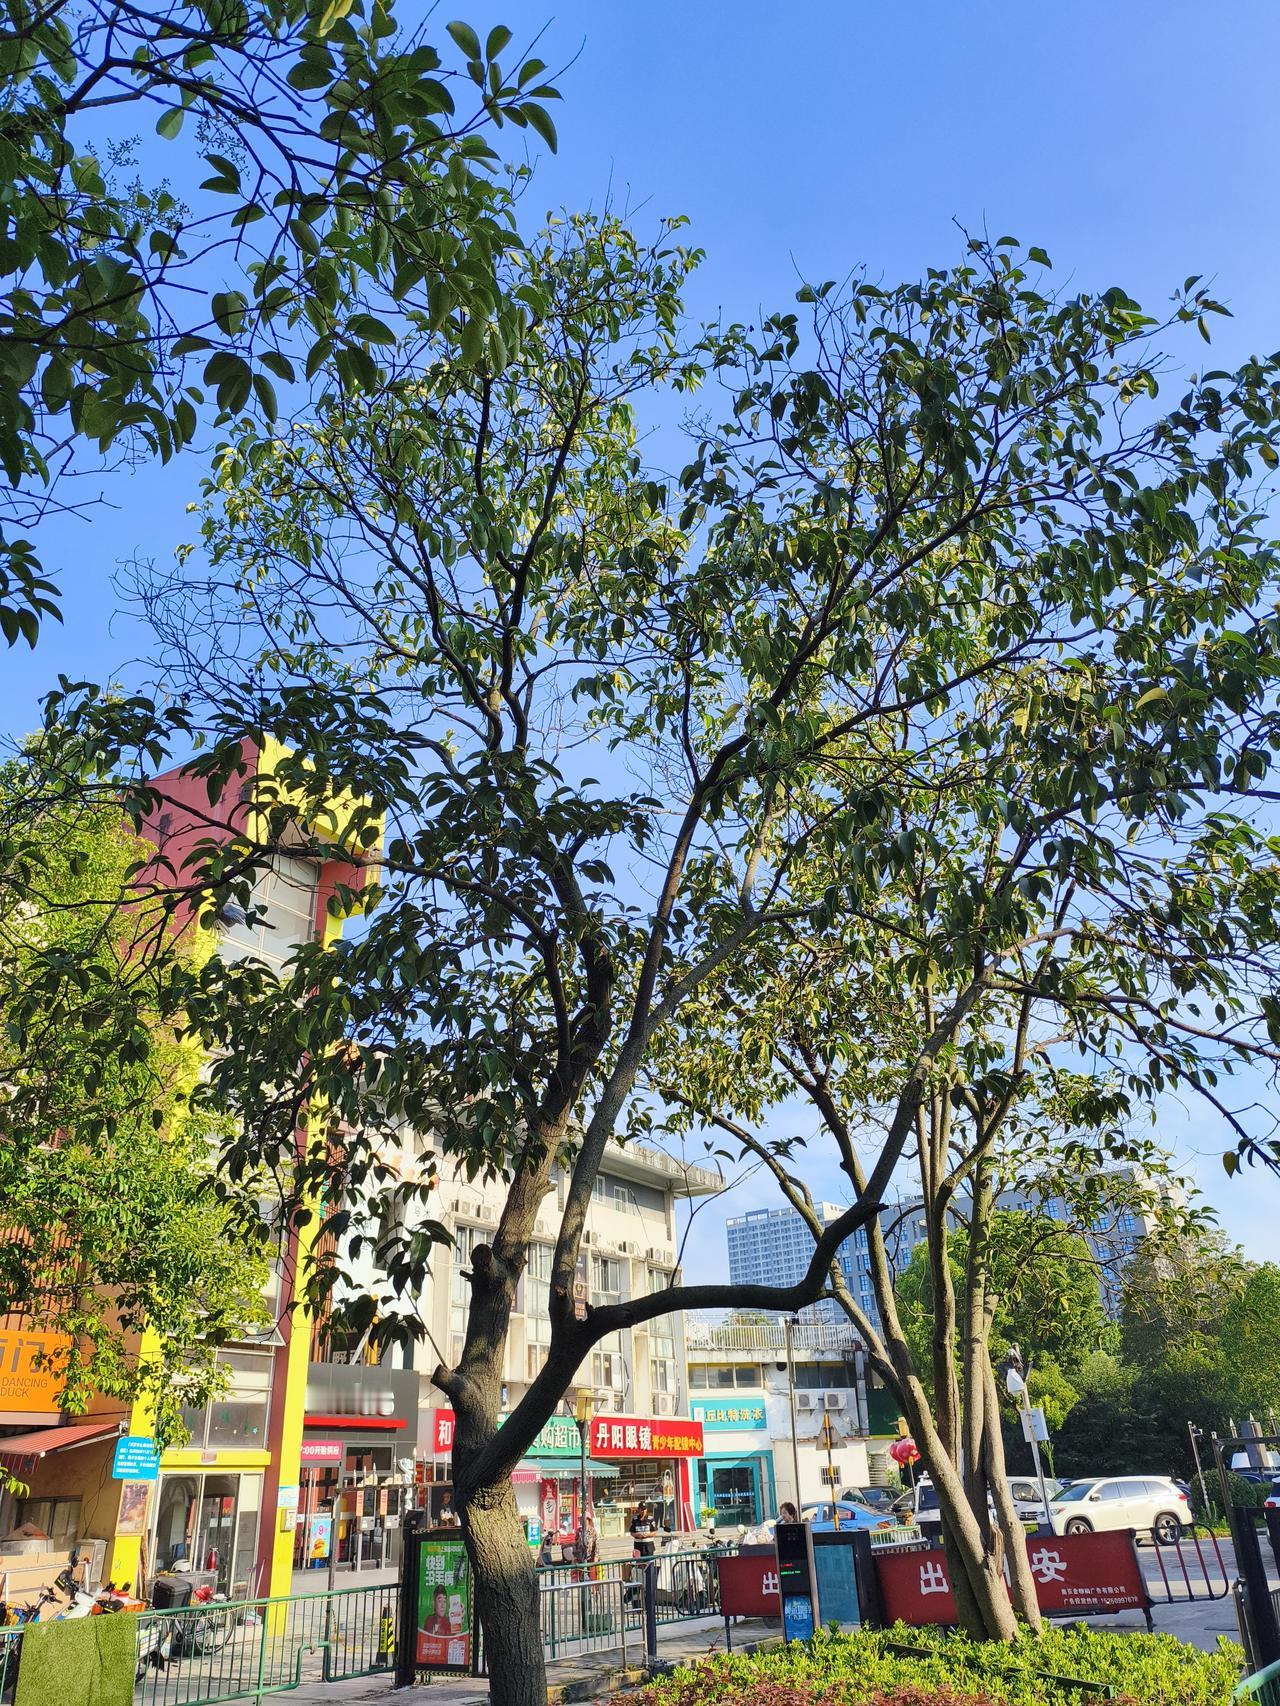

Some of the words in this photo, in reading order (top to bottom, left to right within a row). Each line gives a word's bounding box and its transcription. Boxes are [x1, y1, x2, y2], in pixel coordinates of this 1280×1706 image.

[1, 1377, 48, 1388] DANCING
[0, 1387, 29, 1398] DUCK
[705, 1407, 764, 1422] 丘比特洗衣
[596, 1422, 652, 1451] 丹阳眼镜
[651, 1434, 703, 1452] 青少年配镜中心
[762, 1571, 780, 1595] 出
